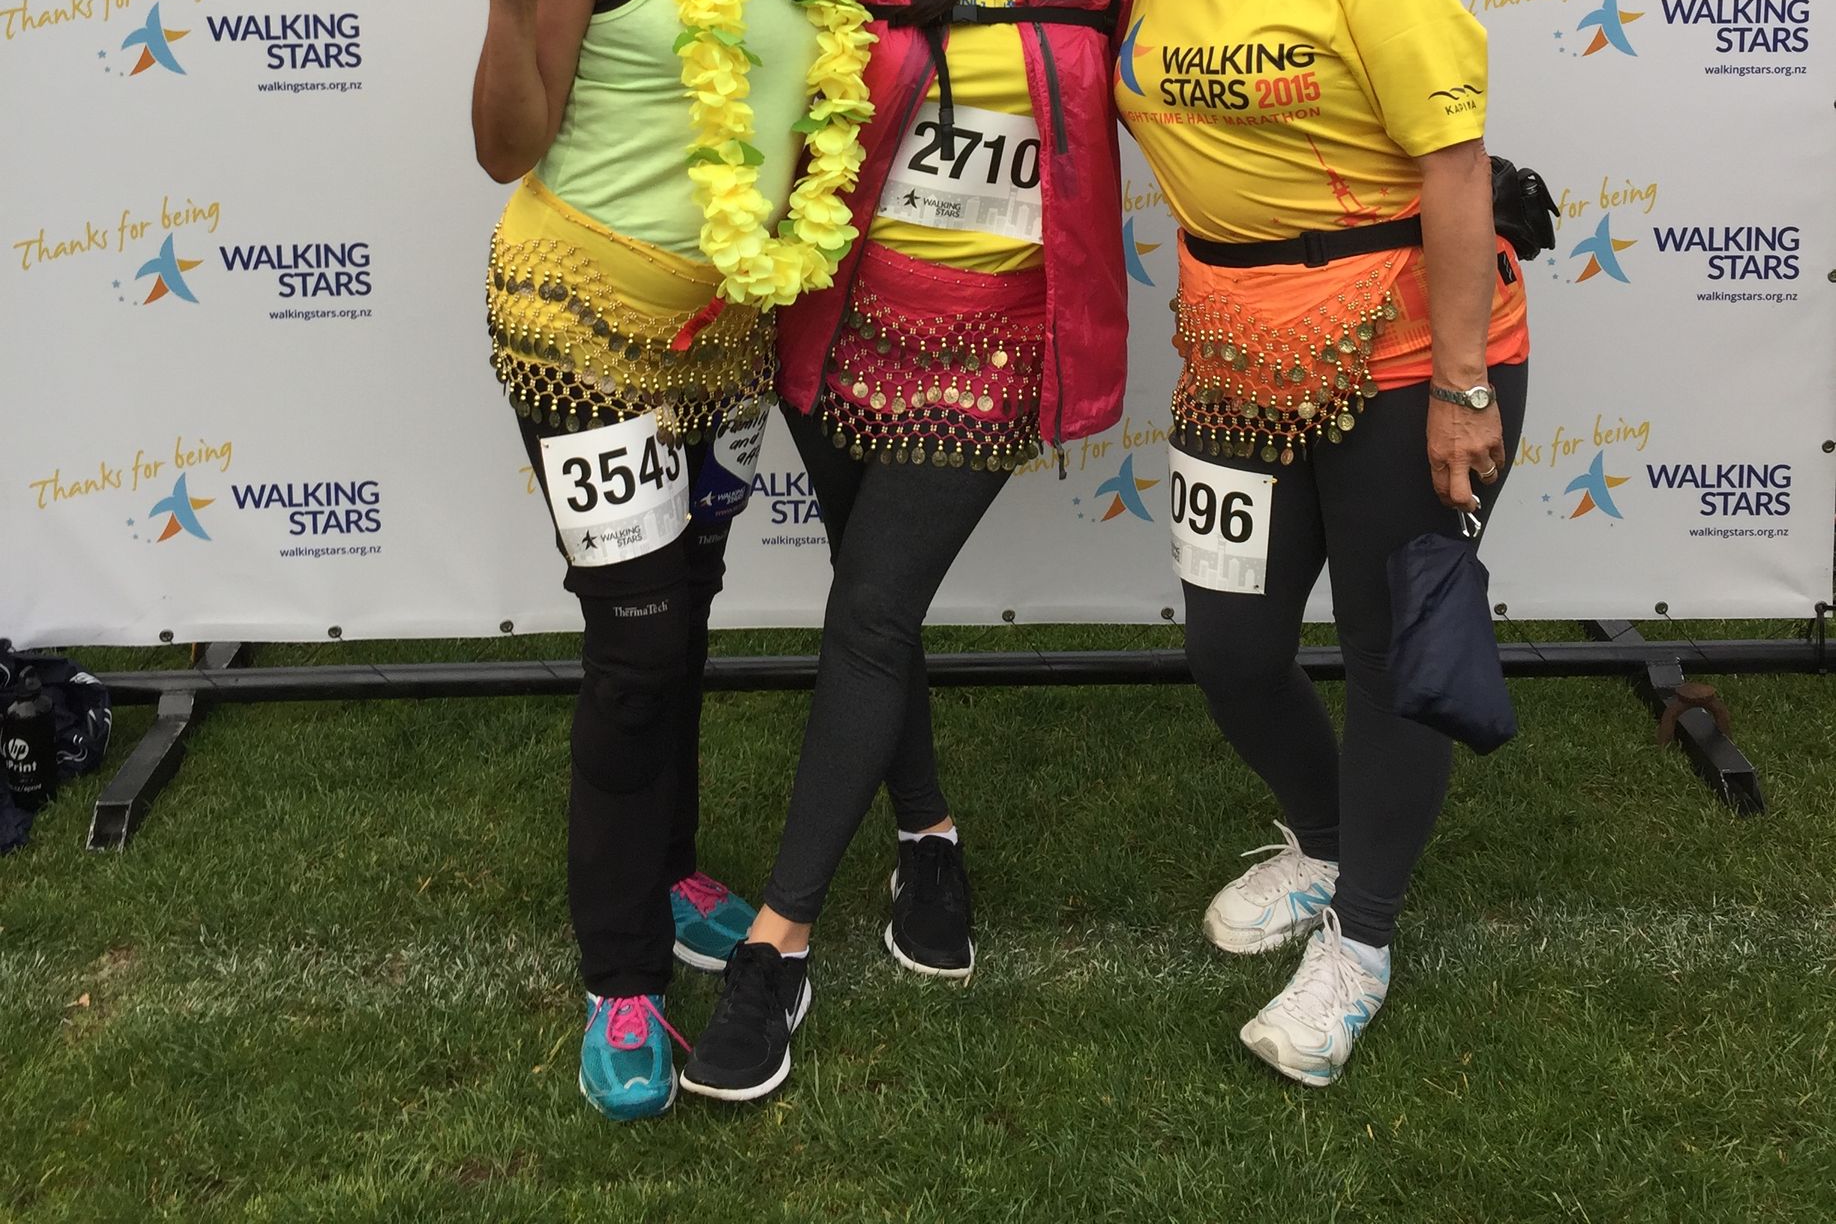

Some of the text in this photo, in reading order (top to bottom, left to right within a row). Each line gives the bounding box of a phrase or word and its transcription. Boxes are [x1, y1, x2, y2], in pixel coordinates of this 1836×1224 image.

[206, 13, 361, 41] WALKING
[1715, 26, 1810, 54] STARS
[266, 43, 363, 69] STARS
[1161, 43, 1316, 75] WALKING
[1704, 64, 1808, 77] walkingstars.org.nz
[257, 80, 363, 93] walkingstars.org.nz
[1159, 71, 1321, 110] STARS 2015
[1186, 112, 1220, 126] HALF
[1223, 106, 1321, 127] MARATHON
[907, 121, 1042, 189] 2710
[923, 197, 961, 211] WALKING
[935, 207, 961, 219] STARS
[1554, 175, 1659, 231] for being
[13, 195, 221, 271] Thanks for being
[1653, 226, 1801, 253] WALKING
[218, 242, 372, 271] WALKING
[1707, 254, 1801, 281] STARS
[277, 271, 373, 297] STARS
[1697, 290, 1799, 303] walkingstars.org.nz
[269, 307, 373, 321] walkingstars.org.nz
[729, 431, 760, 451] and
[1550, 426, 1585, 468] for
[1593, 414, 1651, 452] being
[28, 435, 233, 509] Thanks for being
[1645, 464, 1792, 490] WALKING
[230, 480, 381, 509] WALKING
[1169, 470, 1254, 544] 096
[1700, 491, 1792, 516] STARS
[288, 508, 382, 535] STARS
[771, 499, 824, 525] STA
[600, 524, 641, 542] WALKING
[616, 535, 643, 548] STARS
[762, 535, 830, 548] walkingstars.
[1688, 526, 1791, 539] walkingstars.org.nz
[279, 544, 383, 558] walkingstars.org.nz
[9, 738, 29, 760] hp
[6, 759, 37, 773] Print
